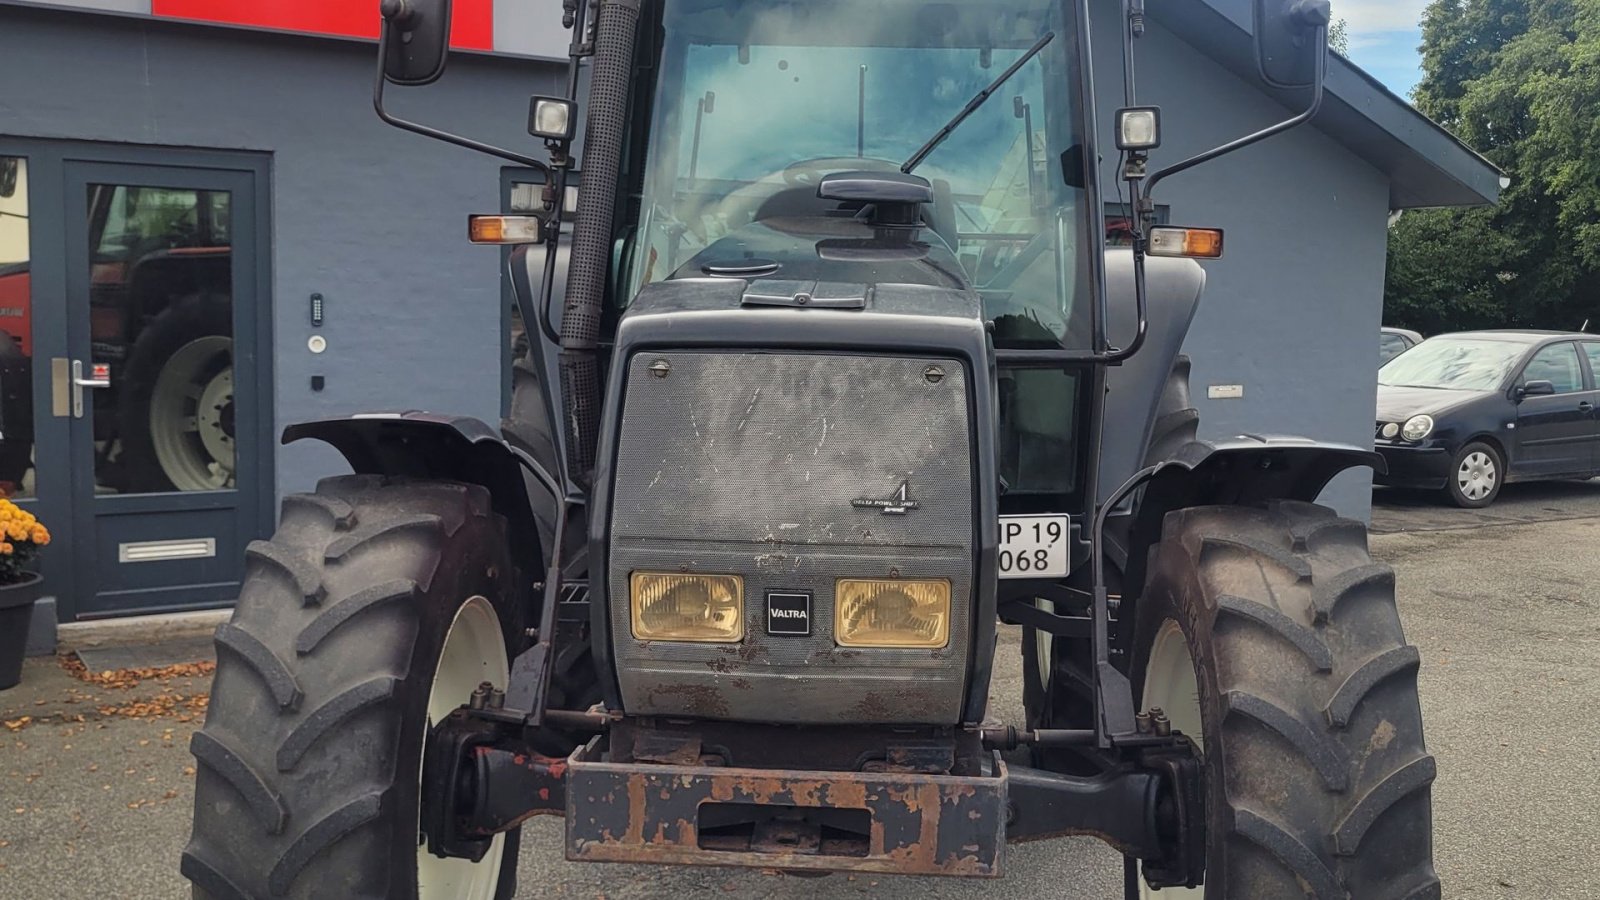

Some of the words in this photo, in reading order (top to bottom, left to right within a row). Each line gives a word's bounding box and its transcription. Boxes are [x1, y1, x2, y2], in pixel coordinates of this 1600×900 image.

[999, 523, 1022, 544] P
[1032, 521, 1061, 544] 19
[999, 549, 1049, 572] 068
[770, 608, 807, 619] VALTRA
